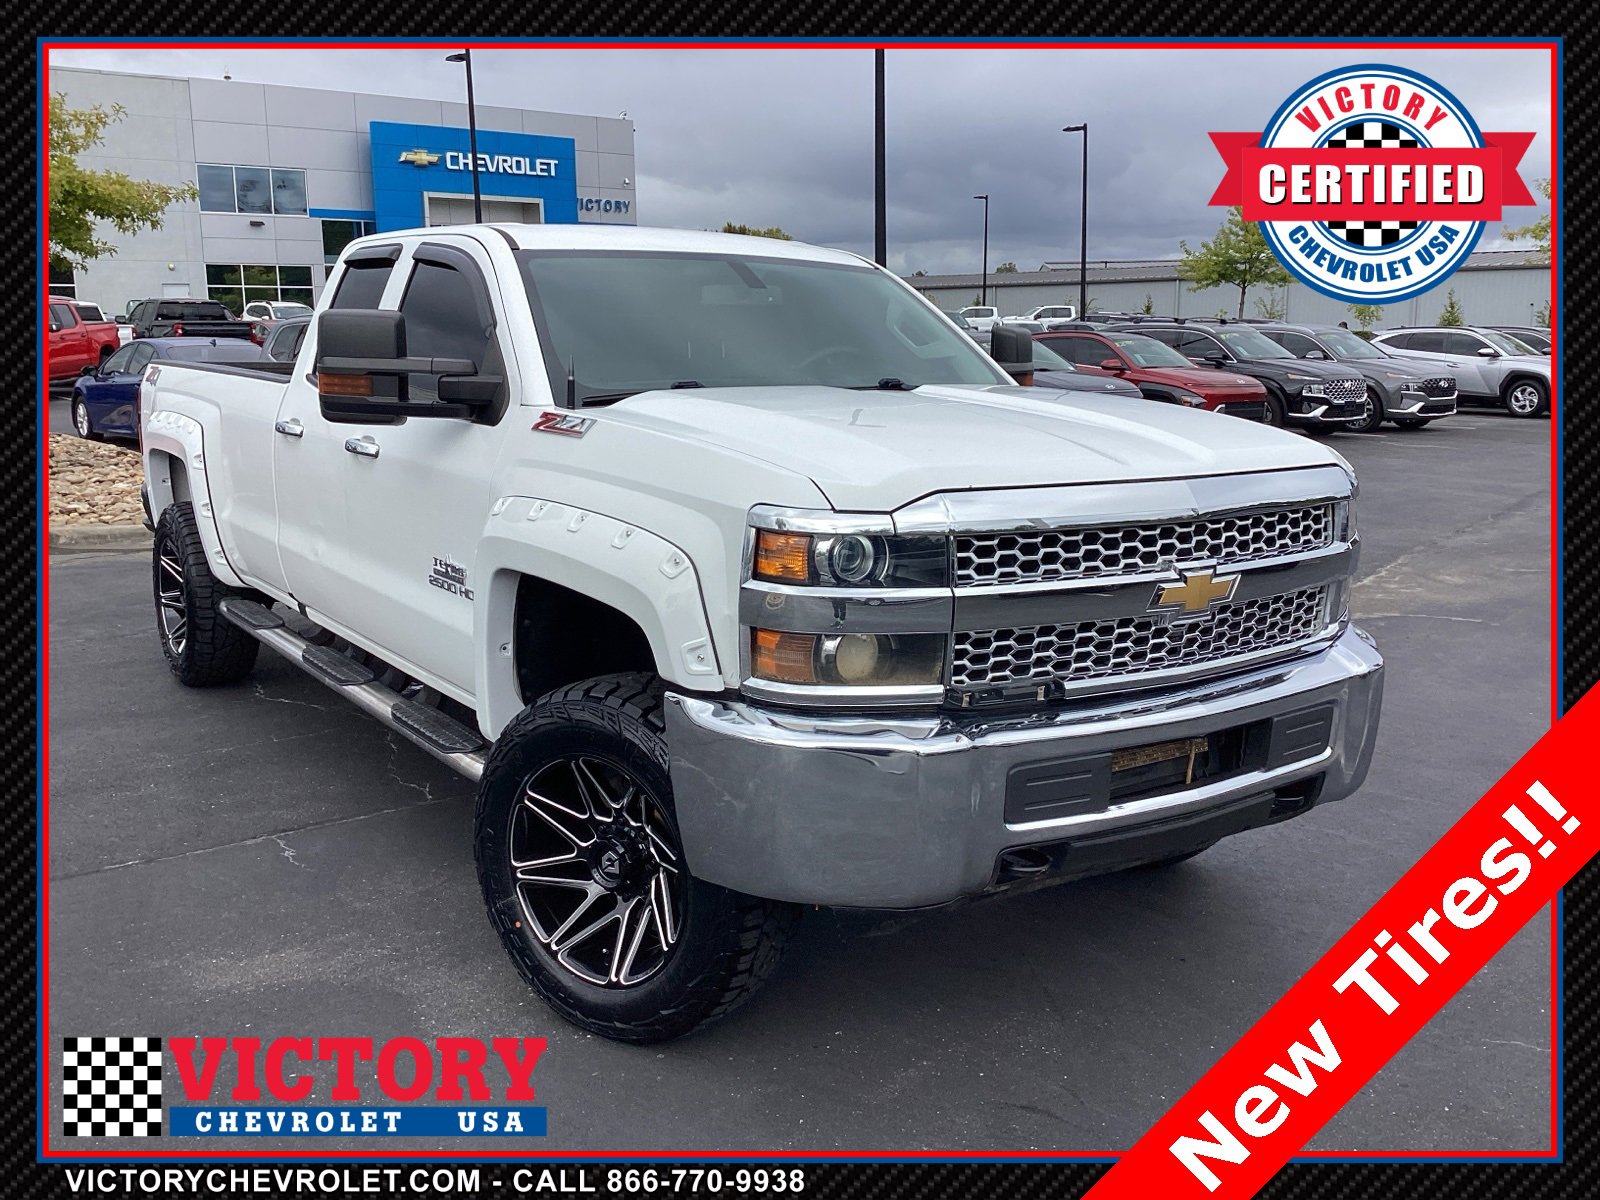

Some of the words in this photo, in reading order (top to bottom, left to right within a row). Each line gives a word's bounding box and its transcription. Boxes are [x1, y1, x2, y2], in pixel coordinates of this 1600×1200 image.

[445, 151, 559, 177] CHEVROLET
[577, 197, 631, 214] ICTORY
[428, 574, 458, 595] 2500
